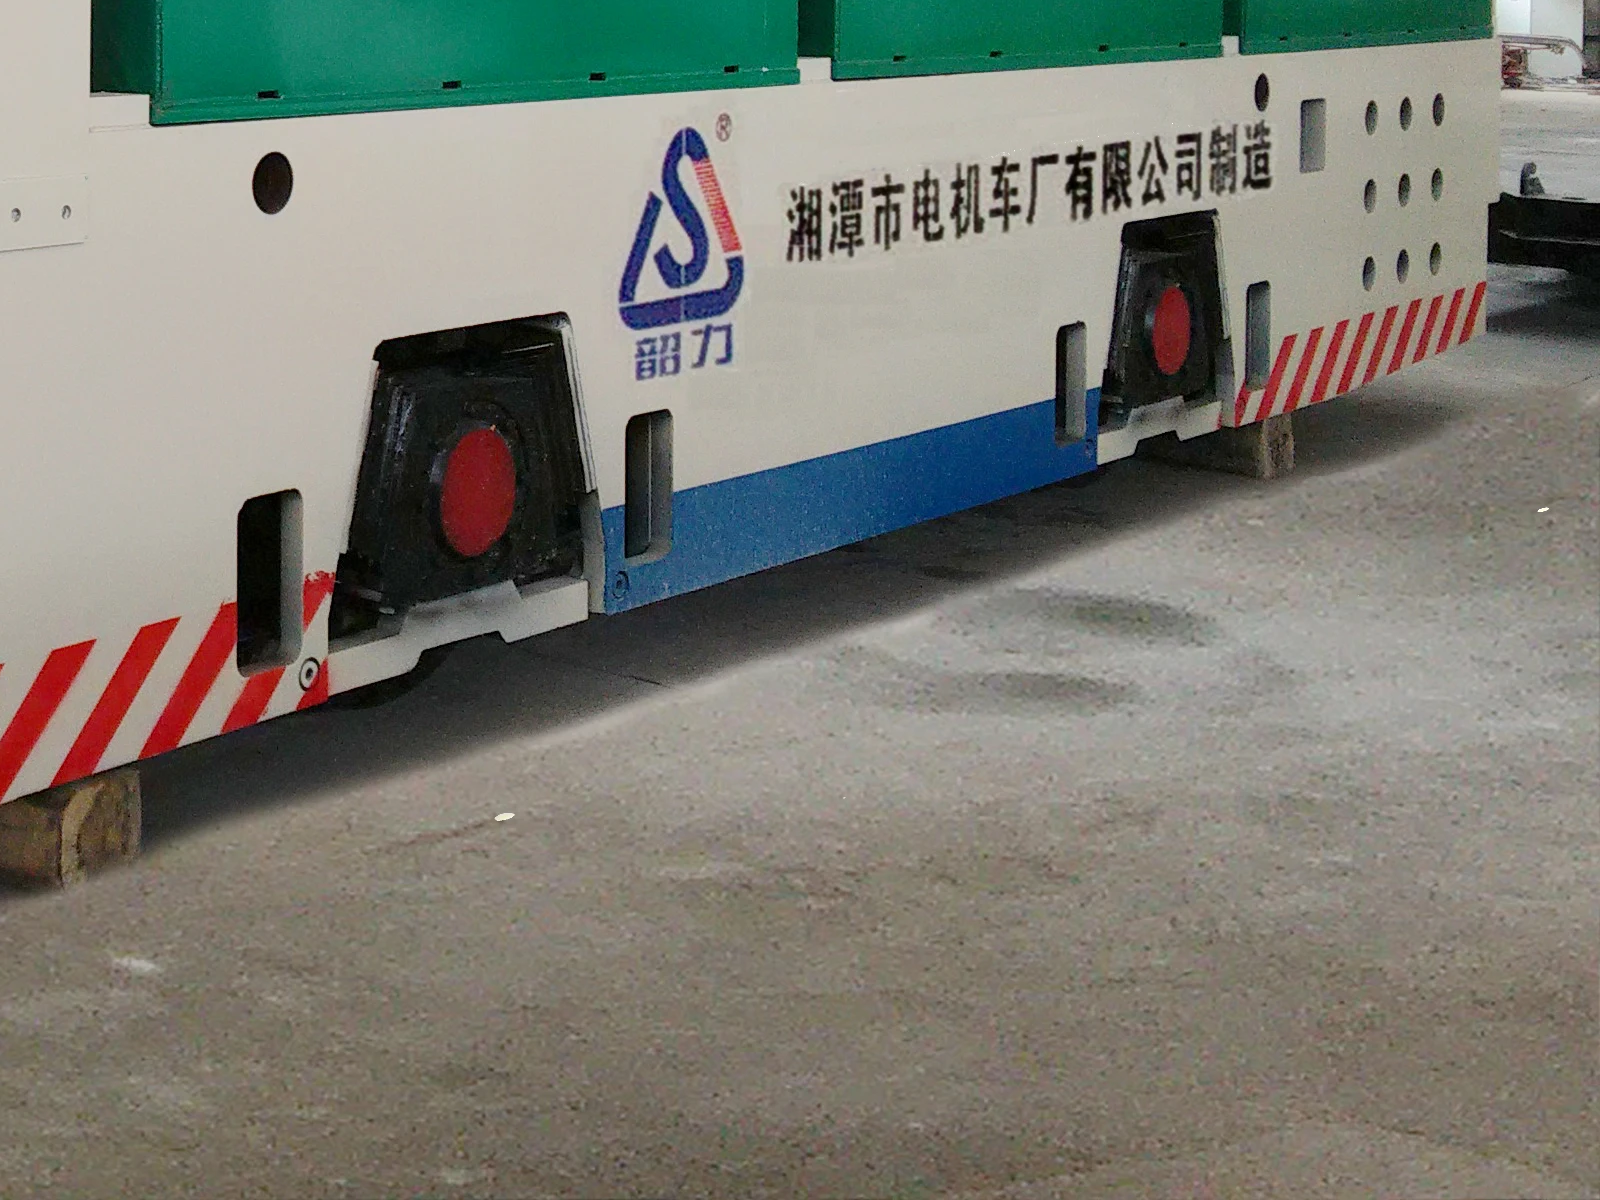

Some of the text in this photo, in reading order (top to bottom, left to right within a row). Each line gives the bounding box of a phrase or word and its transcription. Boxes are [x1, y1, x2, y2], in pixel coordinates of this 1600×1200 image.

[785, 119, 1274, 263] 湘潭市电机车厂有限公司制造
[635, 323, 733, 381] 韶力
